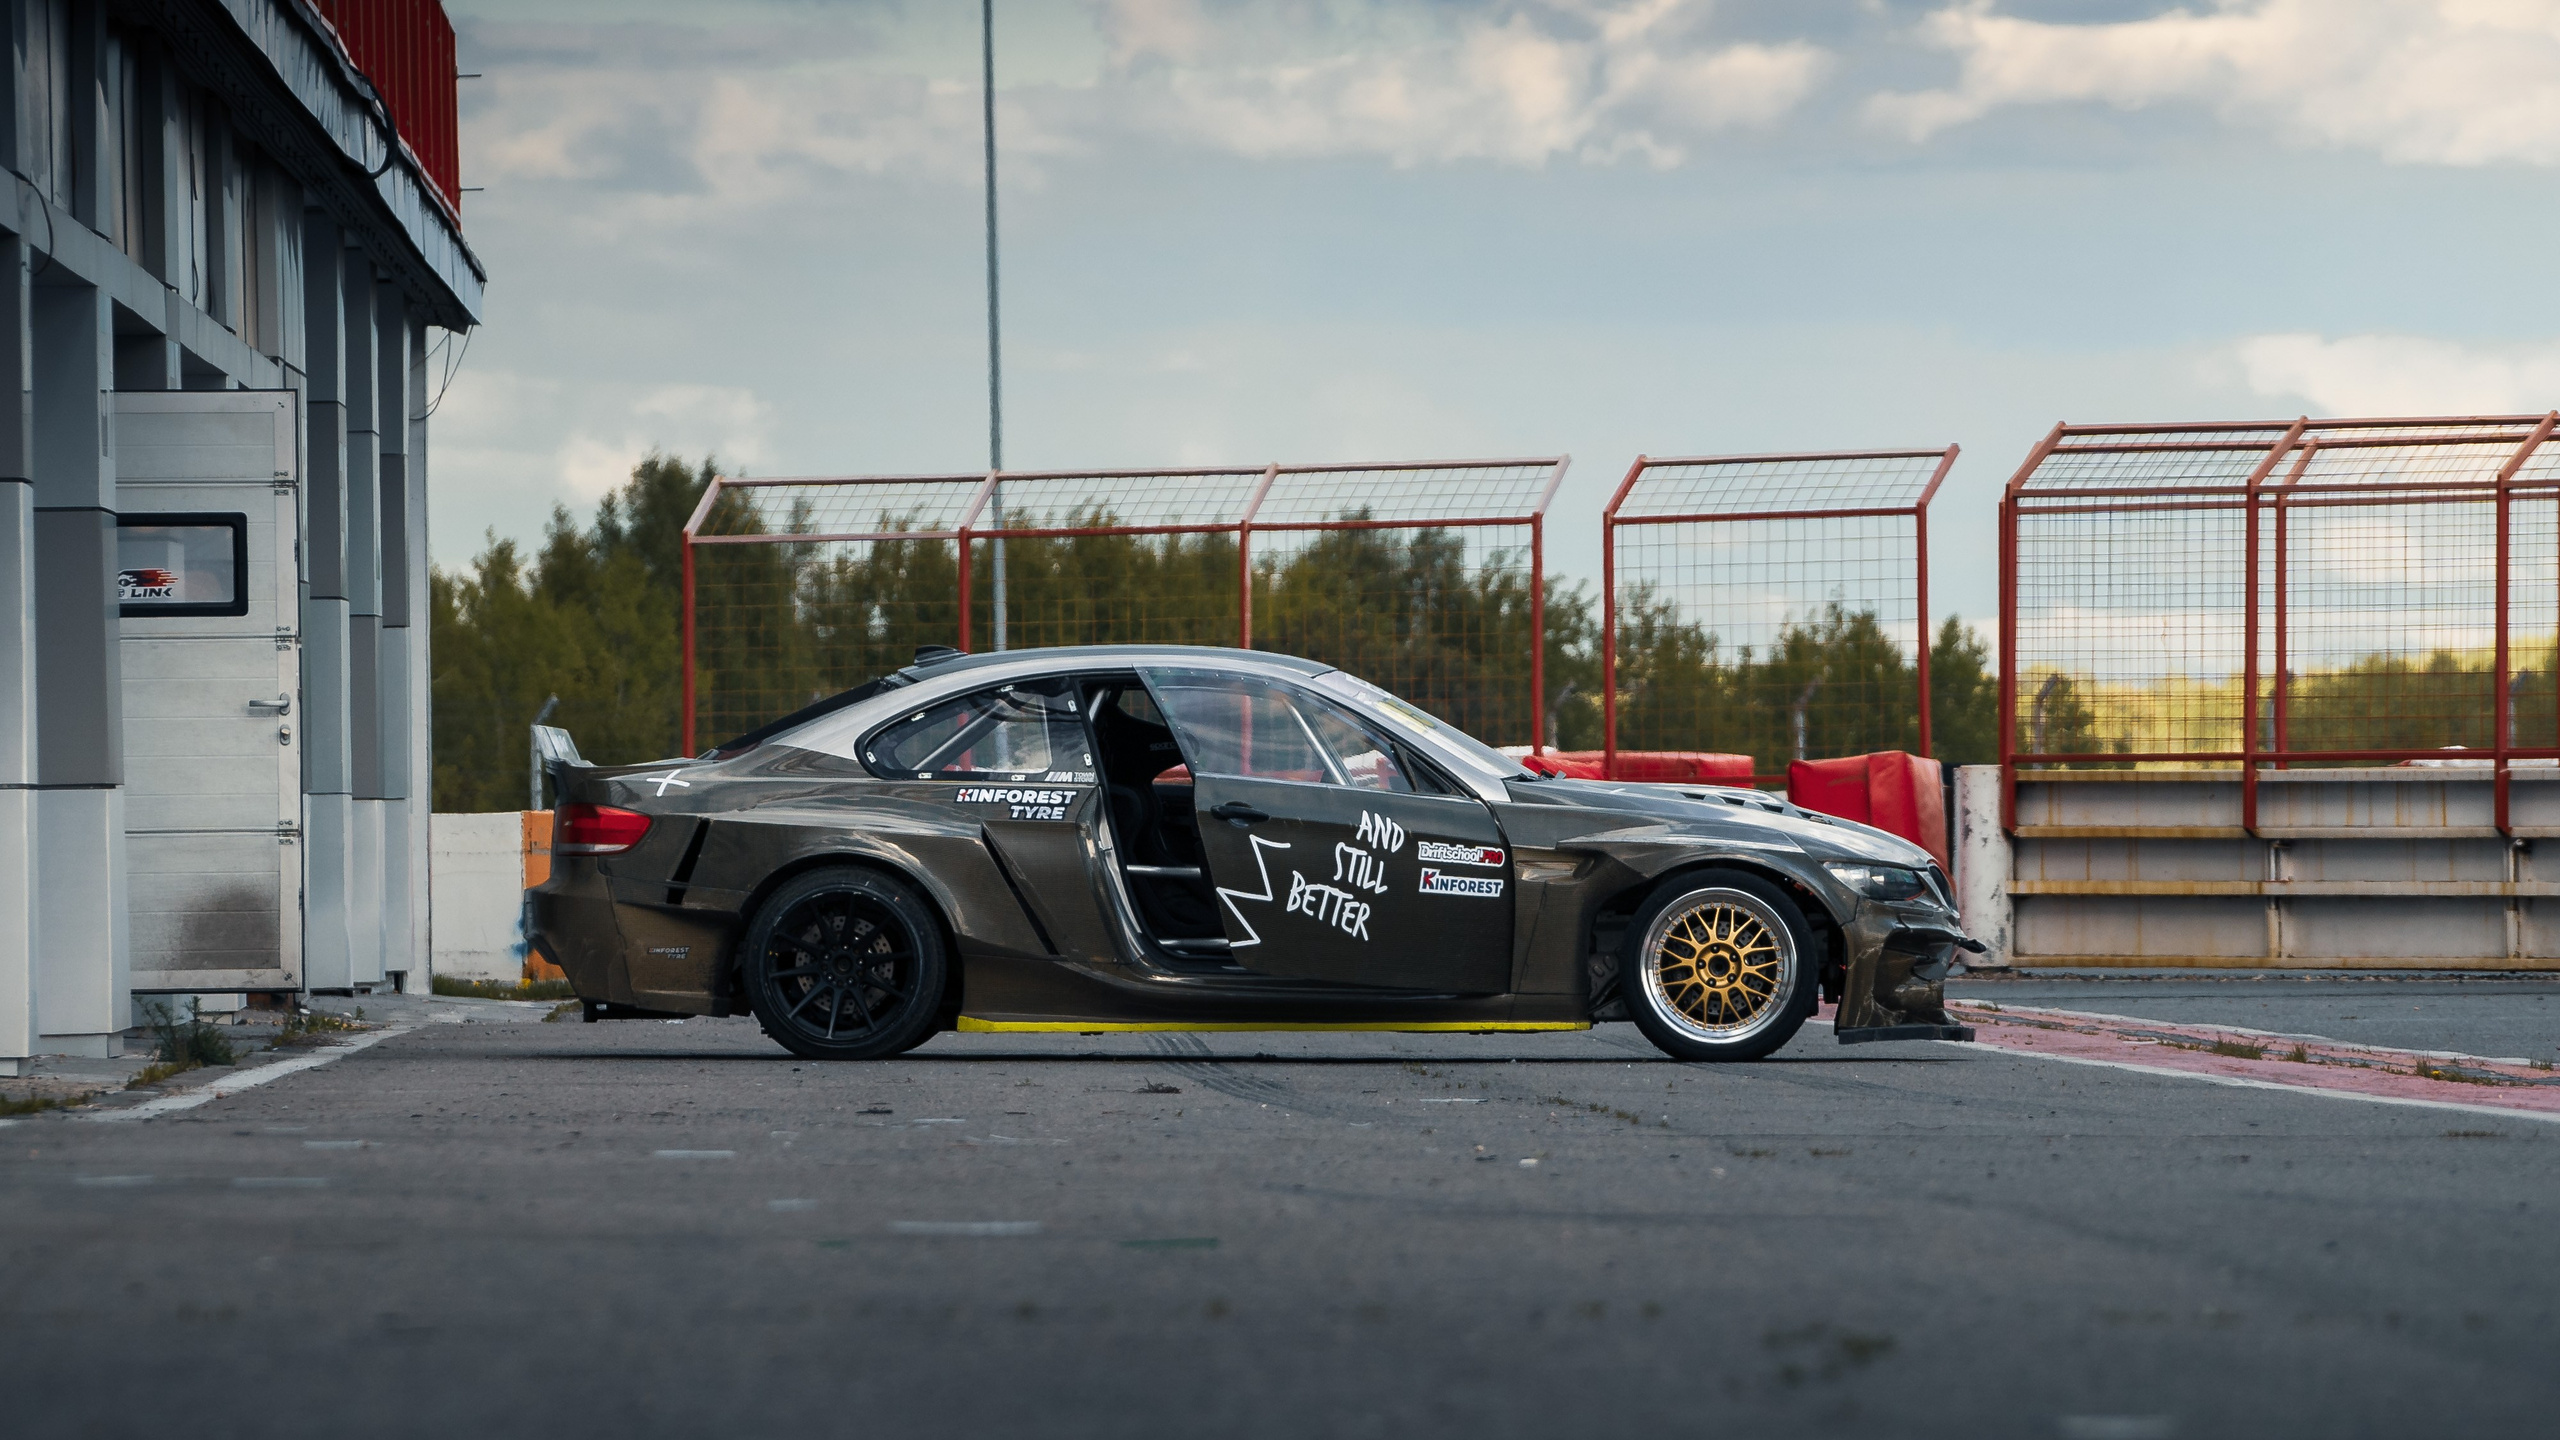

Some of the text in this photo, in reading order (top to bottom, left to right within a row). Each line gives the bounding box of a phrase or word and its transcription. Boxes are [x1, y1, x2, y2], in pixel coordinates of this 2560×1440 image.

[956, 789, 1077, 803] KINFOREST
[1010, 805, 1065, 819] TYRE
[1356, 809, 1404, 853] AND
[1333, 841, 1388, 894] STILL
[1422, 871, 1501, 894] KINFOREST
[1286, 870, 1369, 941] BETTER
